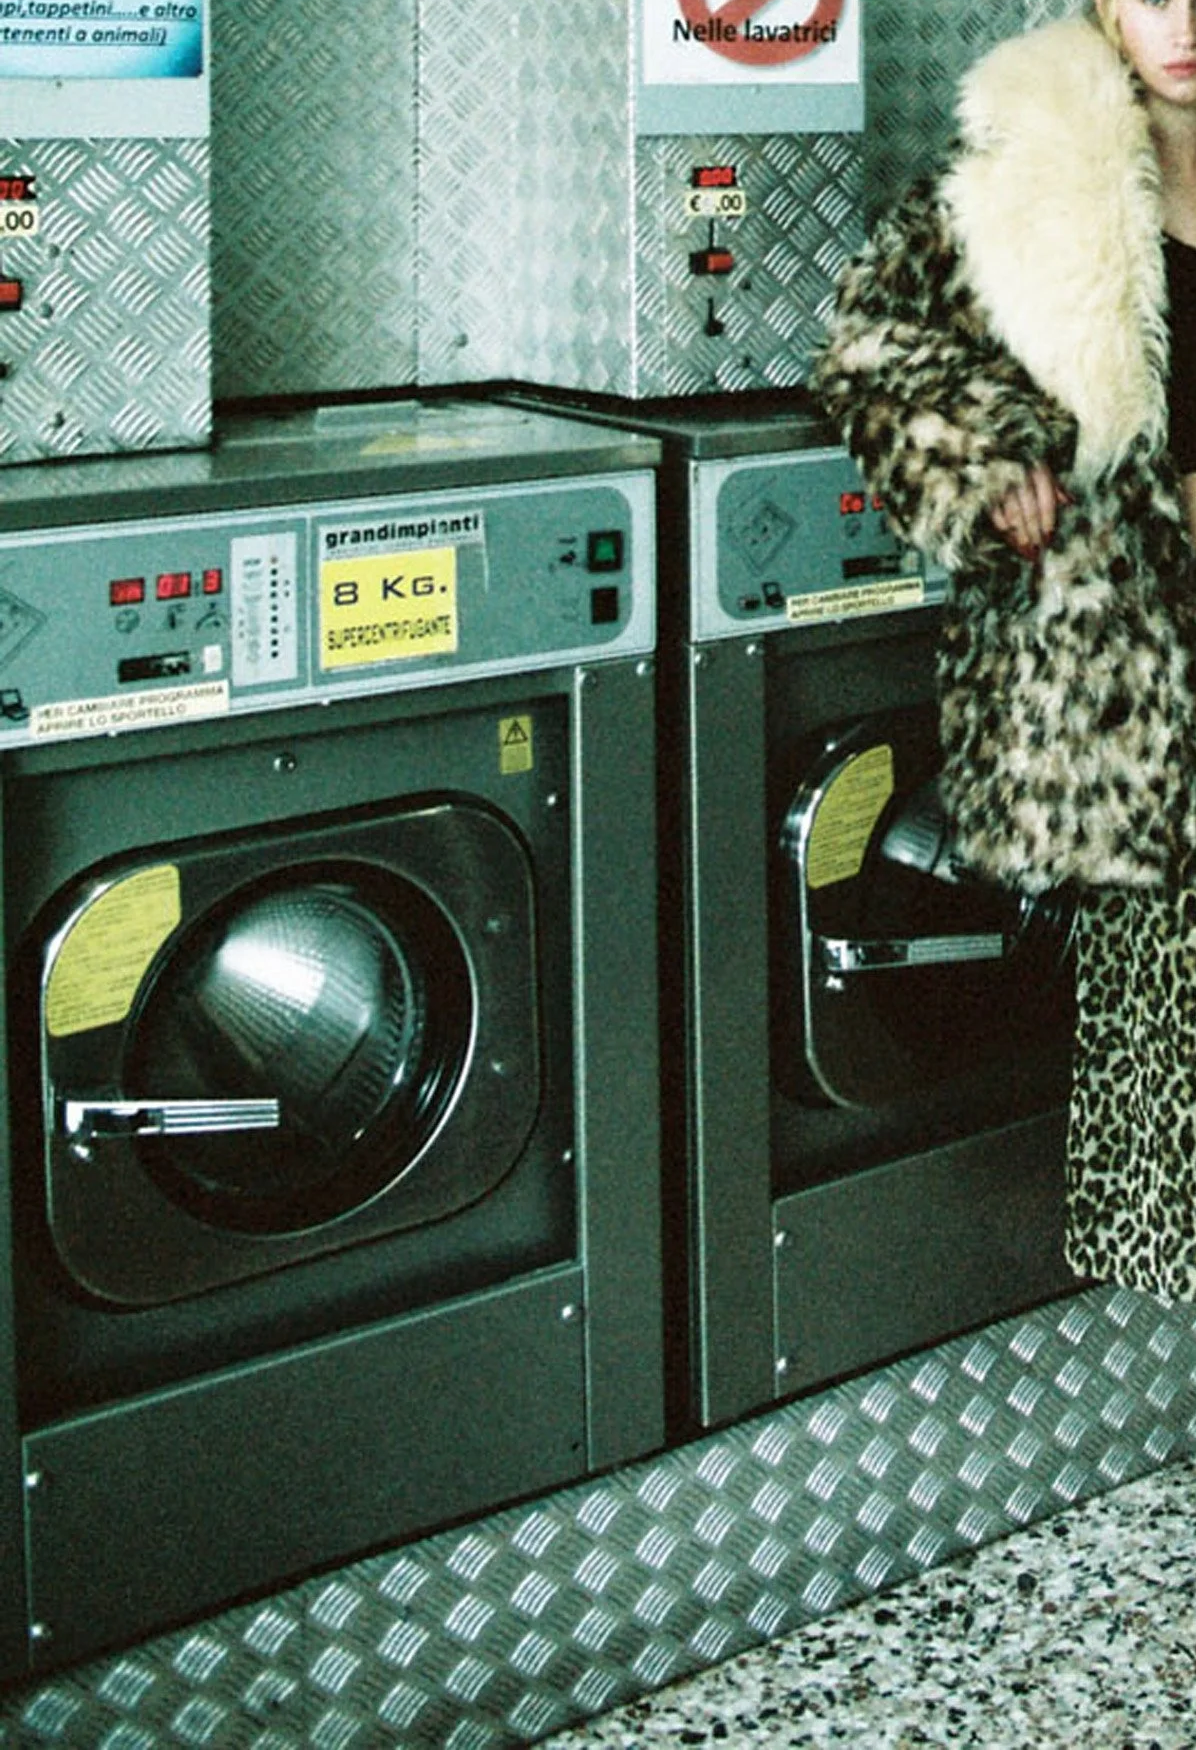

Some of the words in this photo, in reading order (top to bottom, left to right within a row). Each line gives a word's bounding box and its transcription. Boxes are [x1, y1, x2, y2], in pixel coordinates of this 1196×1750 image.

[154, 1, 197, 18] altro
[75, 30, 87, 42] a
[92, 26, 167, 46] animali)
[673, 19, 737, 42] Nelle
[744, 19, 836, 43] lavatrici
[325, 513, 479, 548] grandimpianti
[334, 581, 359, 606] 8
[382, 575, 447, 601] KG.
[139, 685, 224, 705] PROGRAMMA
[111, 704, 187, 723] SPORTELLO
